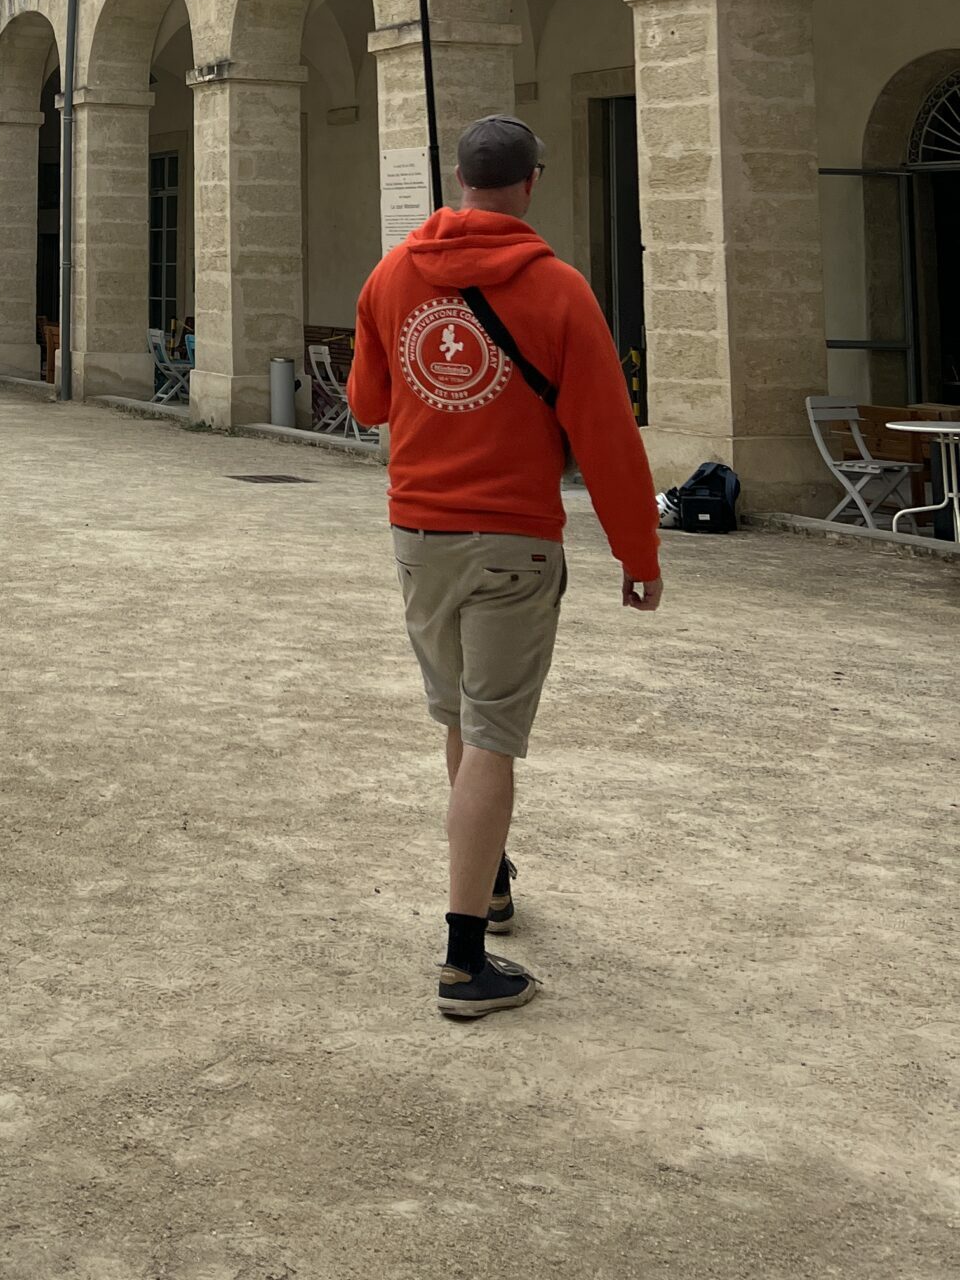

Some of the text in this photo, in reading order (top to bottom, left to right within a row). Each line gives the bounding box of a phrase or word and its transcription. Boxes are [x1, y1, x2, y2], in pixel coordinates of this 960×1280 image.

[409, 330, 420, 361] WHERE
[416, 309, 458, 331] EVERYONE
[488, 345, 498, 369] PLAY
